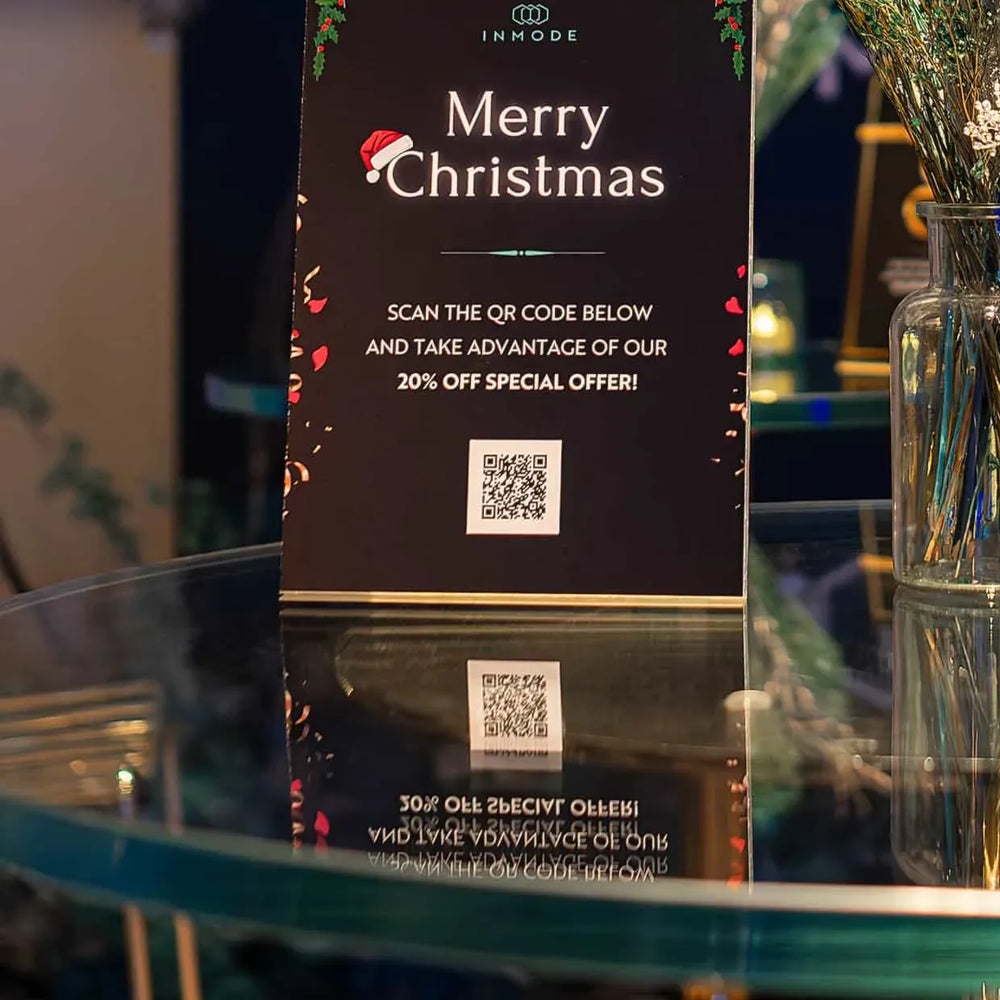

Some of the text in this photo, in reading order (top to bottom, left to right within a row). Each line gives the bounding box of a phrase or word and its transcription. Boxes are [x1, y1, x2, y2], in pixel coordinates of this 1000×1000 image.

[482, 29, 578, 42] INMODE
[446, 90, 610, 151] Merry
[386, 150, 666, 198] Christmas
[387, 304, 654, 326] SCAN THE QR CODE BELOW
[365, 338, 668, 357] AND TAKE ADVANTAGE OF OUR
[396, 372, 638, 391] 20% OFF SPECIAL OFFER!
